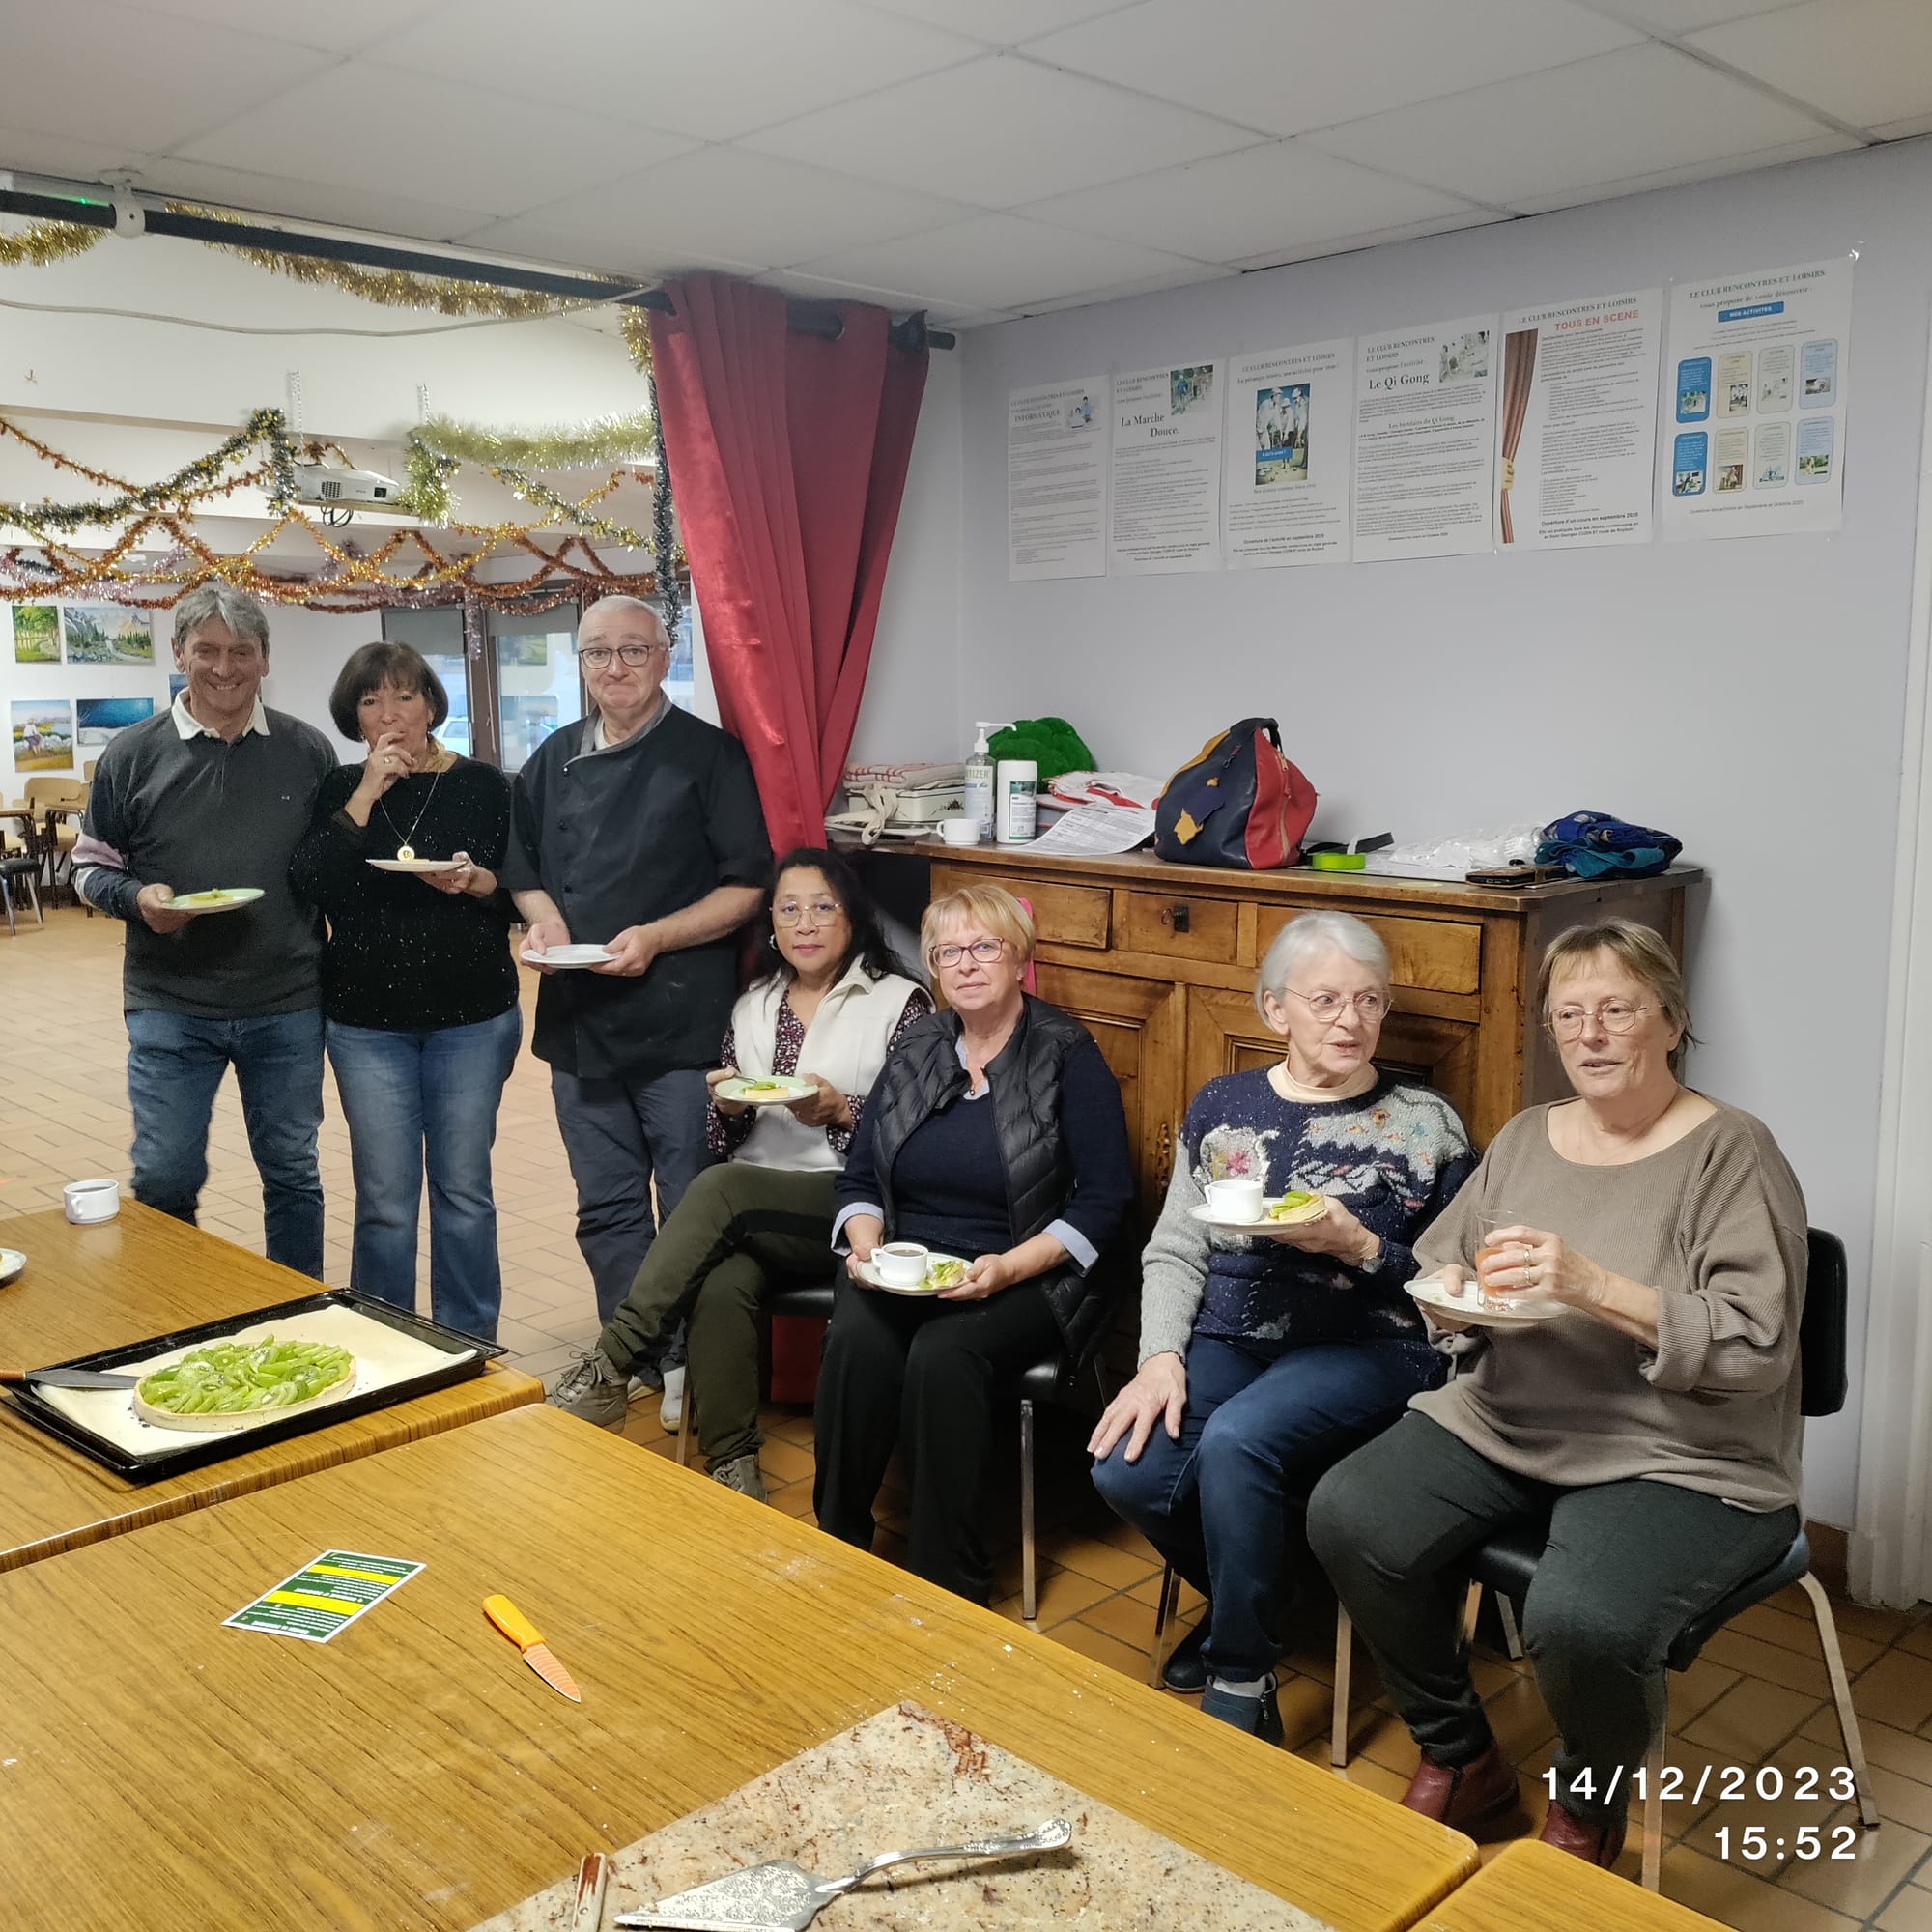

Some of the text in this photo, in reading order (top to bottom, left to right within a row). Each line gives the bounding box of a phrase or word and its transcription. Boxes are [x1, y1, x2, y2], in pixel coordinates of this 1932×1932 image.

[1700, 287, 1721, 297] CLUB
[1721, 277, 1778, 294] RENCONTRES
[1792, 270, 1826, 282] LOISIRS
[1528, 313, 1547, 323] CLUB
[1548, 304, 1596, 319] RENCONTRES
[1607, 297, 1637, 308] LOISIRS
[1554, 309, 1639, 331] TOUS EN SCENE
[1369, 373, 1430, 391] Le Qi Gong
[1121, 412, 1165, 428] La Marche
[1151, 427, 1179, 438] Douce.
